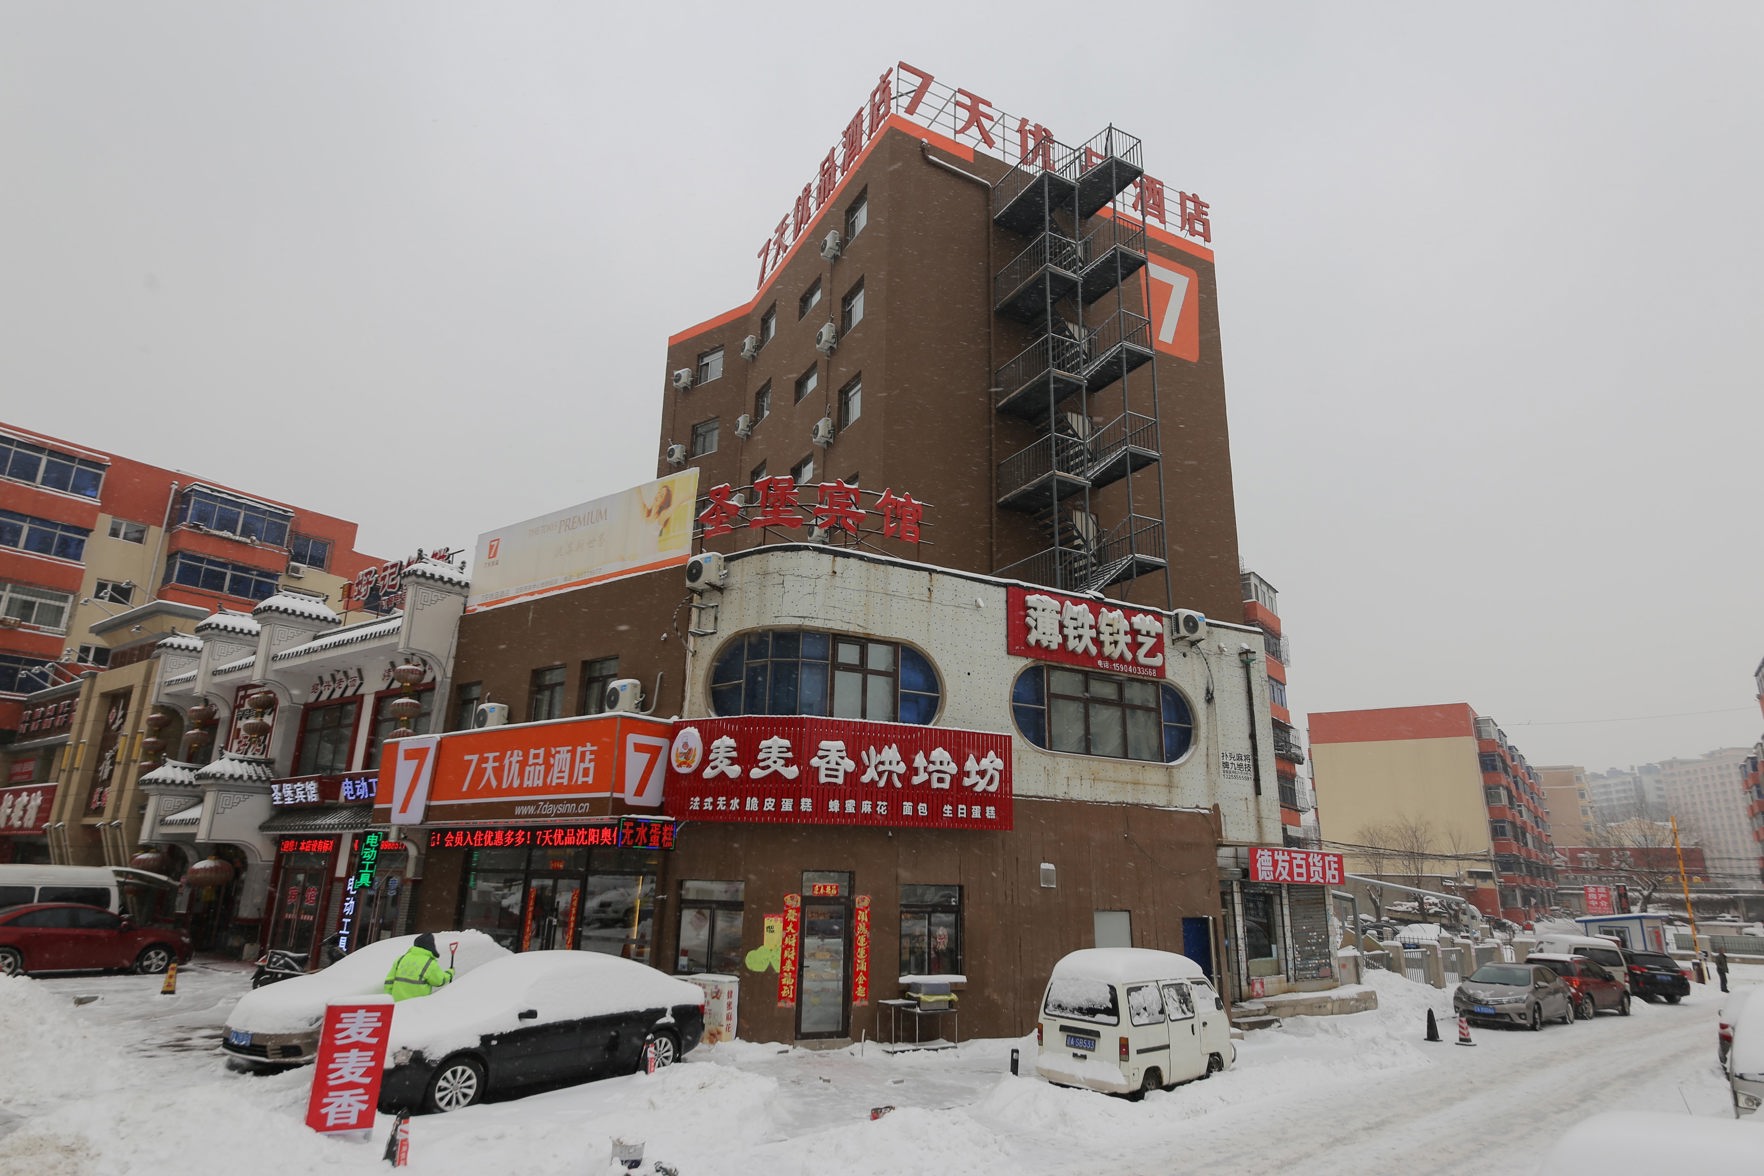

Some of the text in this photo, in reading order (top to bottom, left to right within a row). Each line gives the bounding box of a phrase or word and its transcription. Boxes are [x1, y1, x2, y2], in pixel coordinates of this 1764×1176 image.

[757, 66, 893, 291] 7天优品酒店
[1148, 262, 1189, 345] 7
[558, 507, 608, 534] PREMIUM
[699, 475, 923, 544] 圣堡宾馆
[1025, 593, 1163, 667] 薄铁铁艺
[398, 747, 431, 814] 7
[461, 742, 598, 792] 7天优品酒店
[632, 742, 663, 798] 7
[702, 734, 1005, 793] 麦麦香烘培坊
[270, 780, 320, 805] 圣堡宾馆
[514, 802, 590, 817] www.7daysinn.cn
[902, 801, 928, 816] 面包
[943, 802, 996, 819] 生日蛋糕
[358, 832, 380, 888] 电动工具
[622, 822, 673, 848] 无水蛋糕
[1256, 848, 1339, 884] 德发百货店
[339, 875, 357, 952] 电动工具
[320, 1008, 382, 1127] 麦麦香
